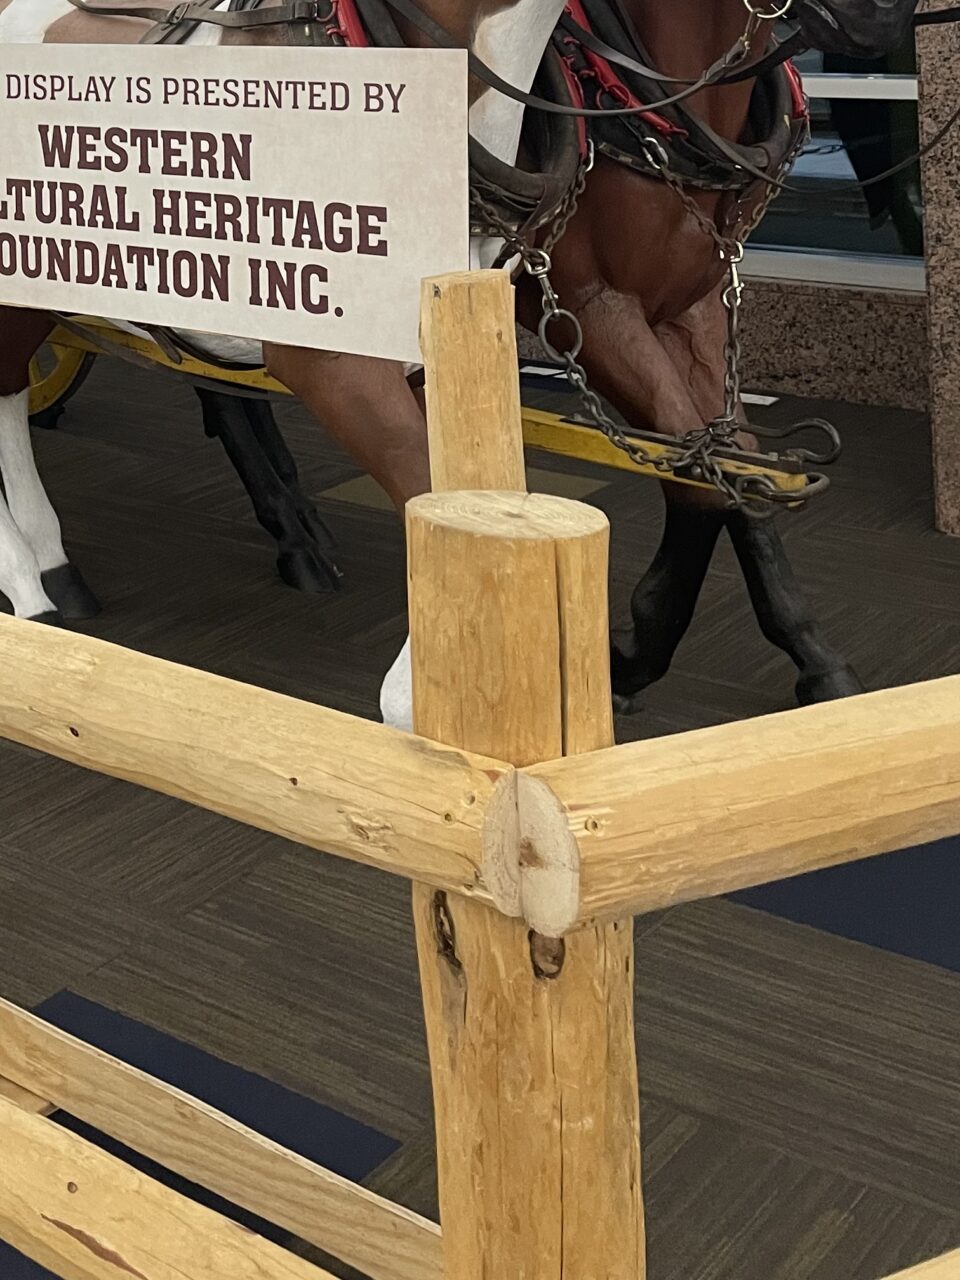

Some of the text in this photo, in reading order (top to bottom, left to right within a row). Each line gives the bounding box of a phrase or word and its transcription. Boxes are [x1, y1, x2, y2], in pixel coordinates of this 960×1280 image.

[5, 73, 117, 103] DISPLAY
[125, 76, 152, 104] IS
[162, 77, 350, 111] PRESENTED
[363, 82, 407, 114] BY
[37, 124, 253, 182] WESTERN
[152, 188, 388, 257] HERITAGE
[247, 257, 344, 318] INC.
